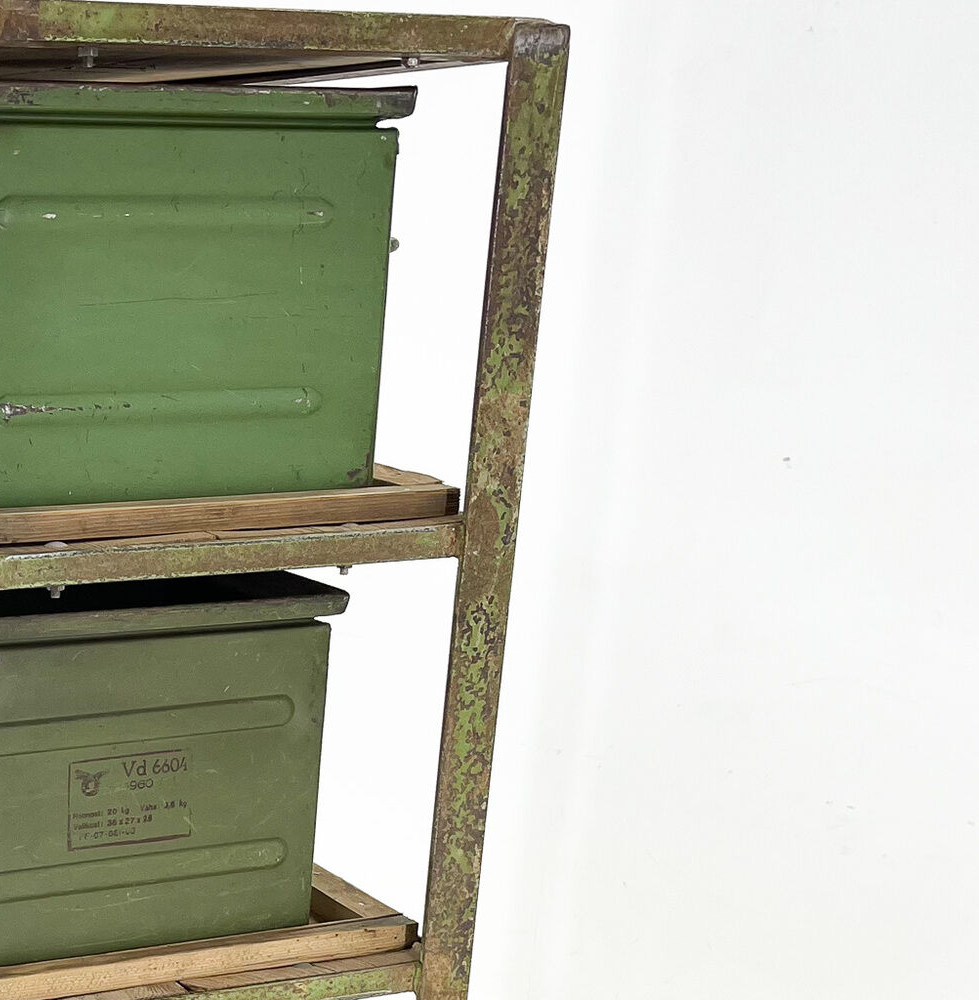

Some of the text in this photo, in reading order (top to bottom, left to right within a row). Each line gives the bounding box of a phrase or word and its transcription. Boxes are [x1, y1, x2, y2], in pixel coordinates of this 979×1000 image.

[121, 756, 188, 778] Vd 6604
[107, 808, 118, 816] 20
